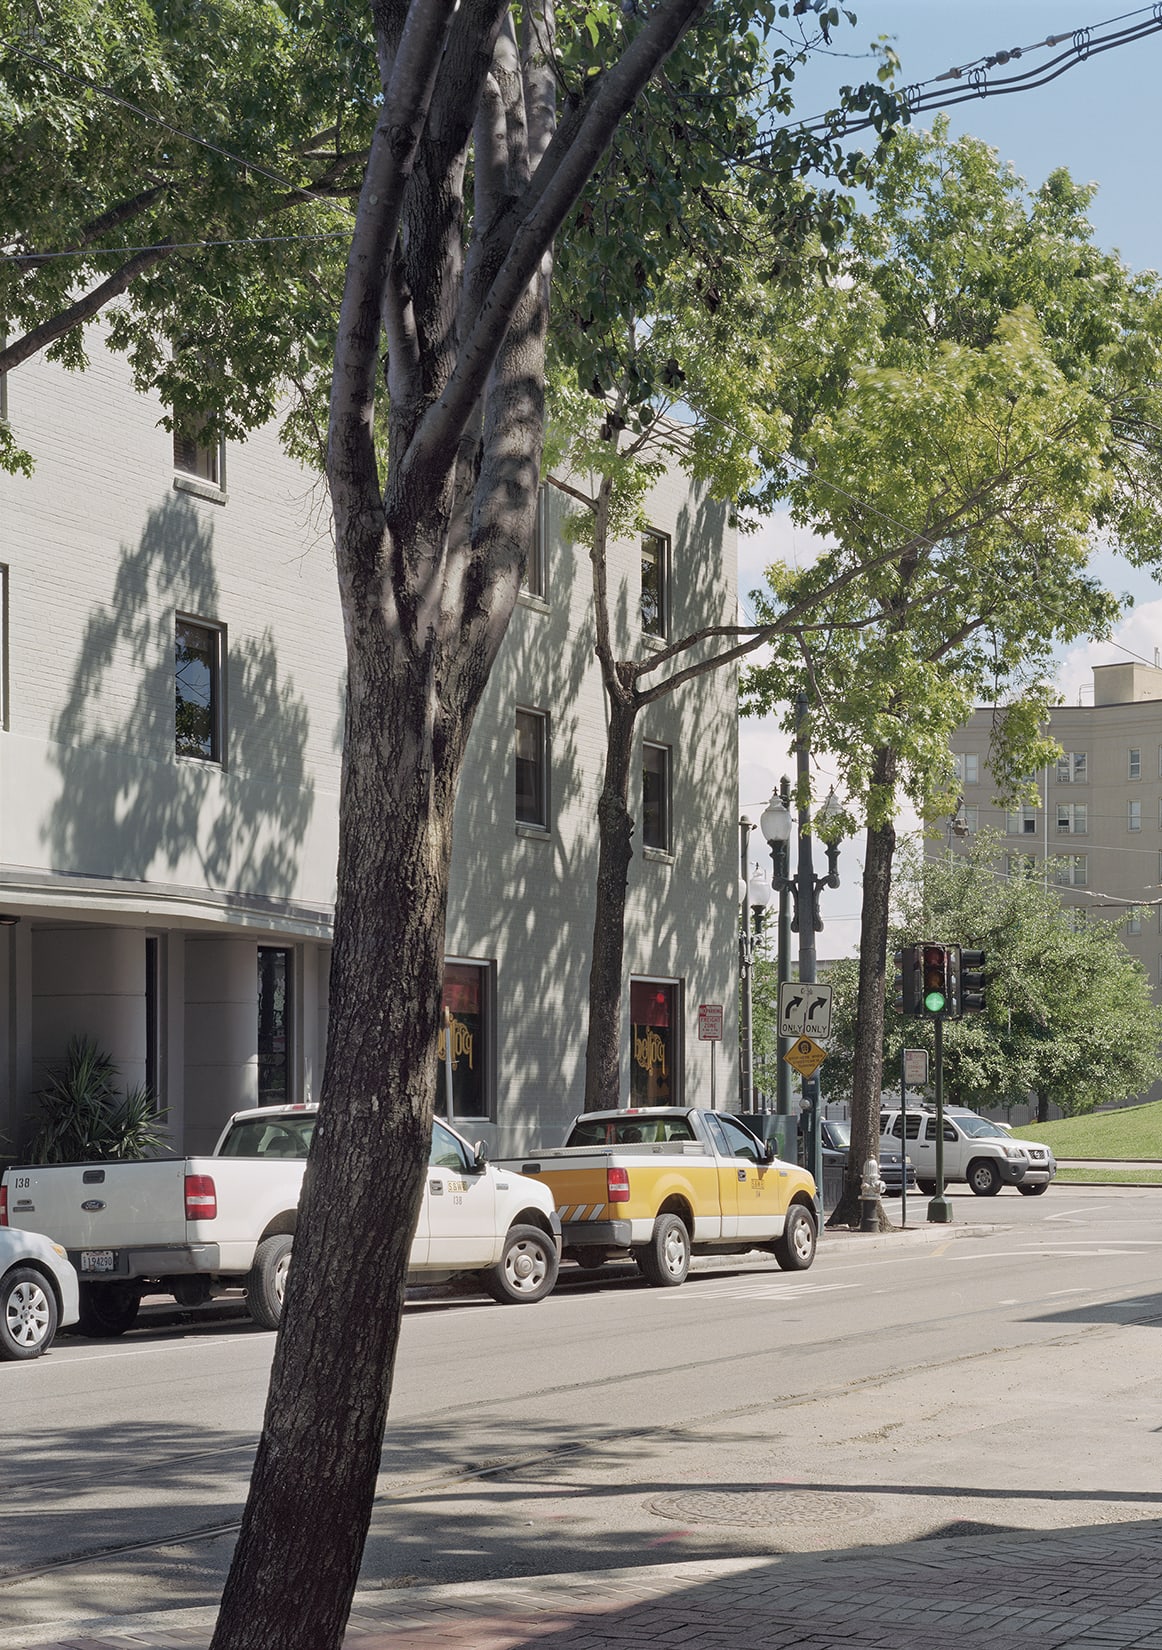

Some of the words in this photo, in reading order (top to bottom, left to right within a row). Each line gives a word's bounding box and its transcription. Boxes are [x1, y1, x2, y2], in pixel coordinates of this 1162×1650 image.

[782, 1023, 803, 1032] ONLY
[806, 1025, 827, 1033] ONLY
[15, 1178, 30, 1189] 138
[453, 1195, 463, 1205] 138
[85, 1201, 101, 1210] Ford
